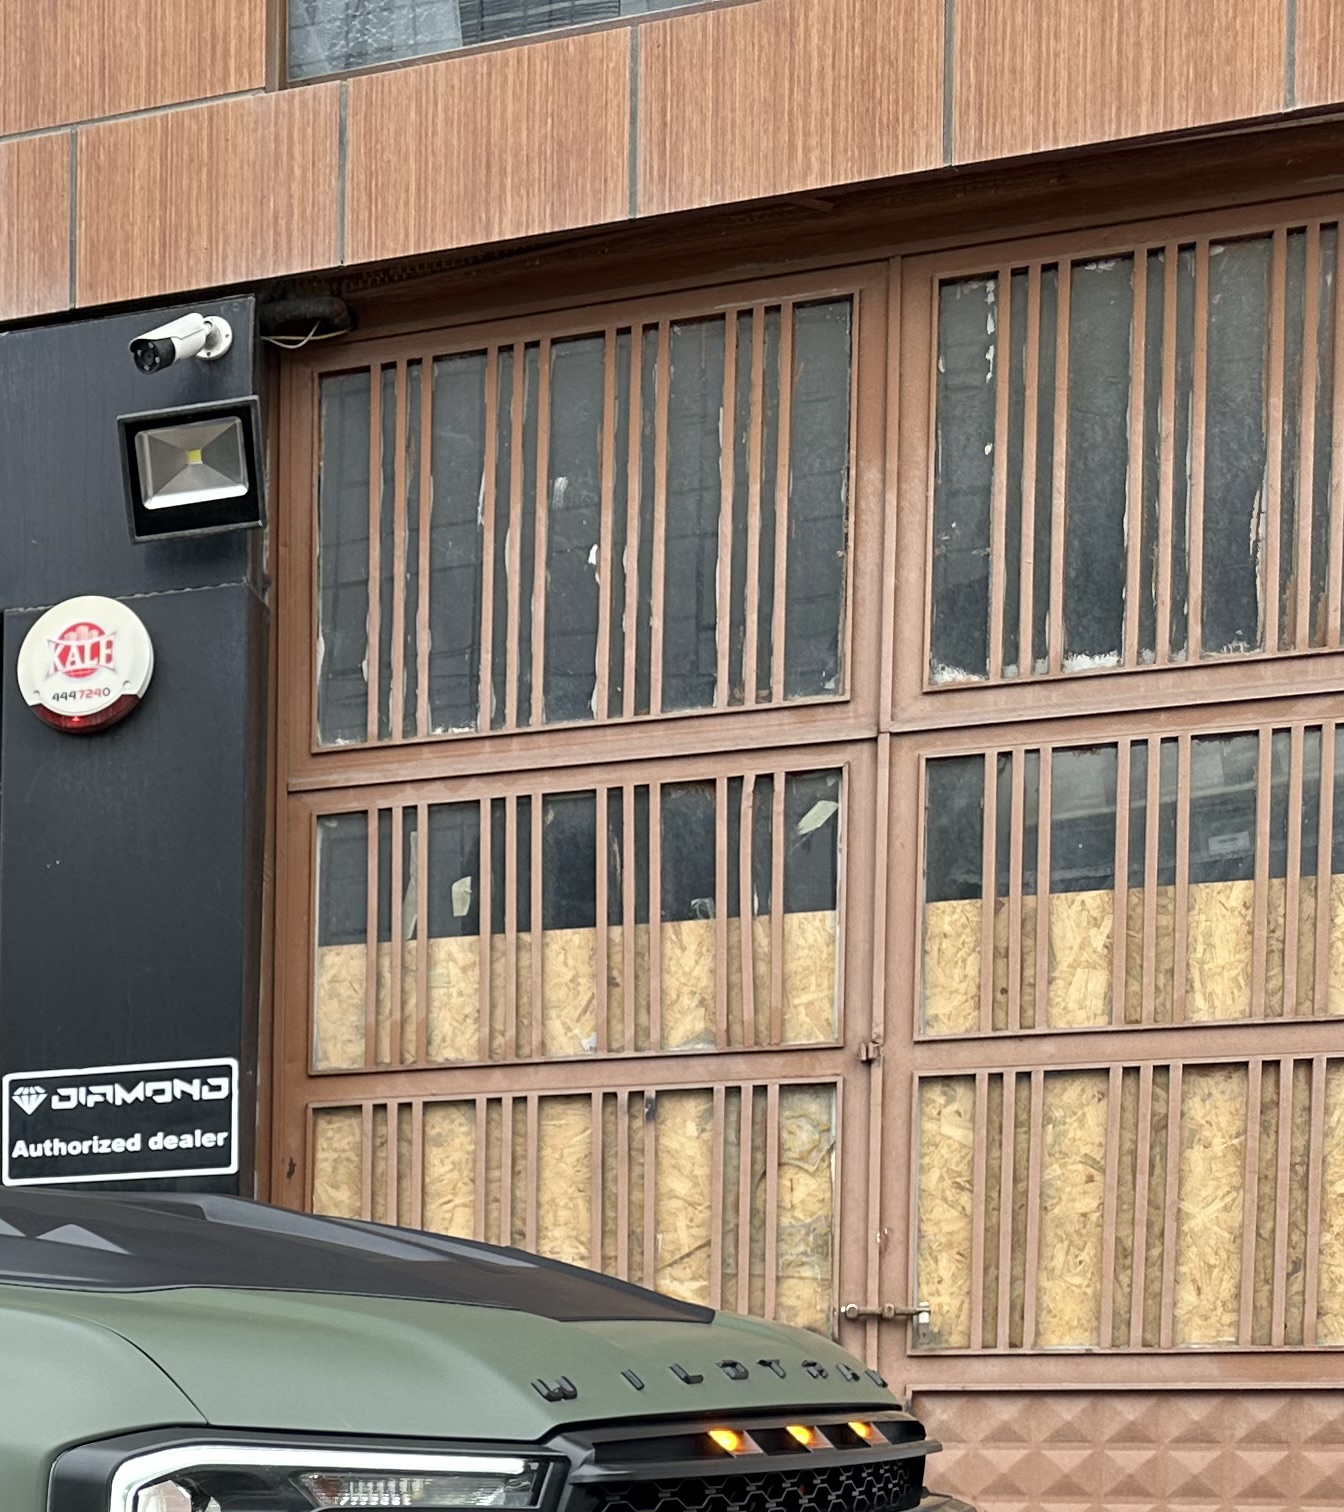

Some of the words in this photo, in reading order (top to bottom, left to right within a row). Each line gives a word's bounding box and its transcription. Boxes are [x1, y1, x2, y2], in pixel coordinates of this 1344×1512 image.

[47, 635, 116, 675] KALE
[50, 1076, 230, 1110] DIAMOND
[11, 1132, 142, 1159] Authorized
[147, 1128, 230, 1151] dealer
